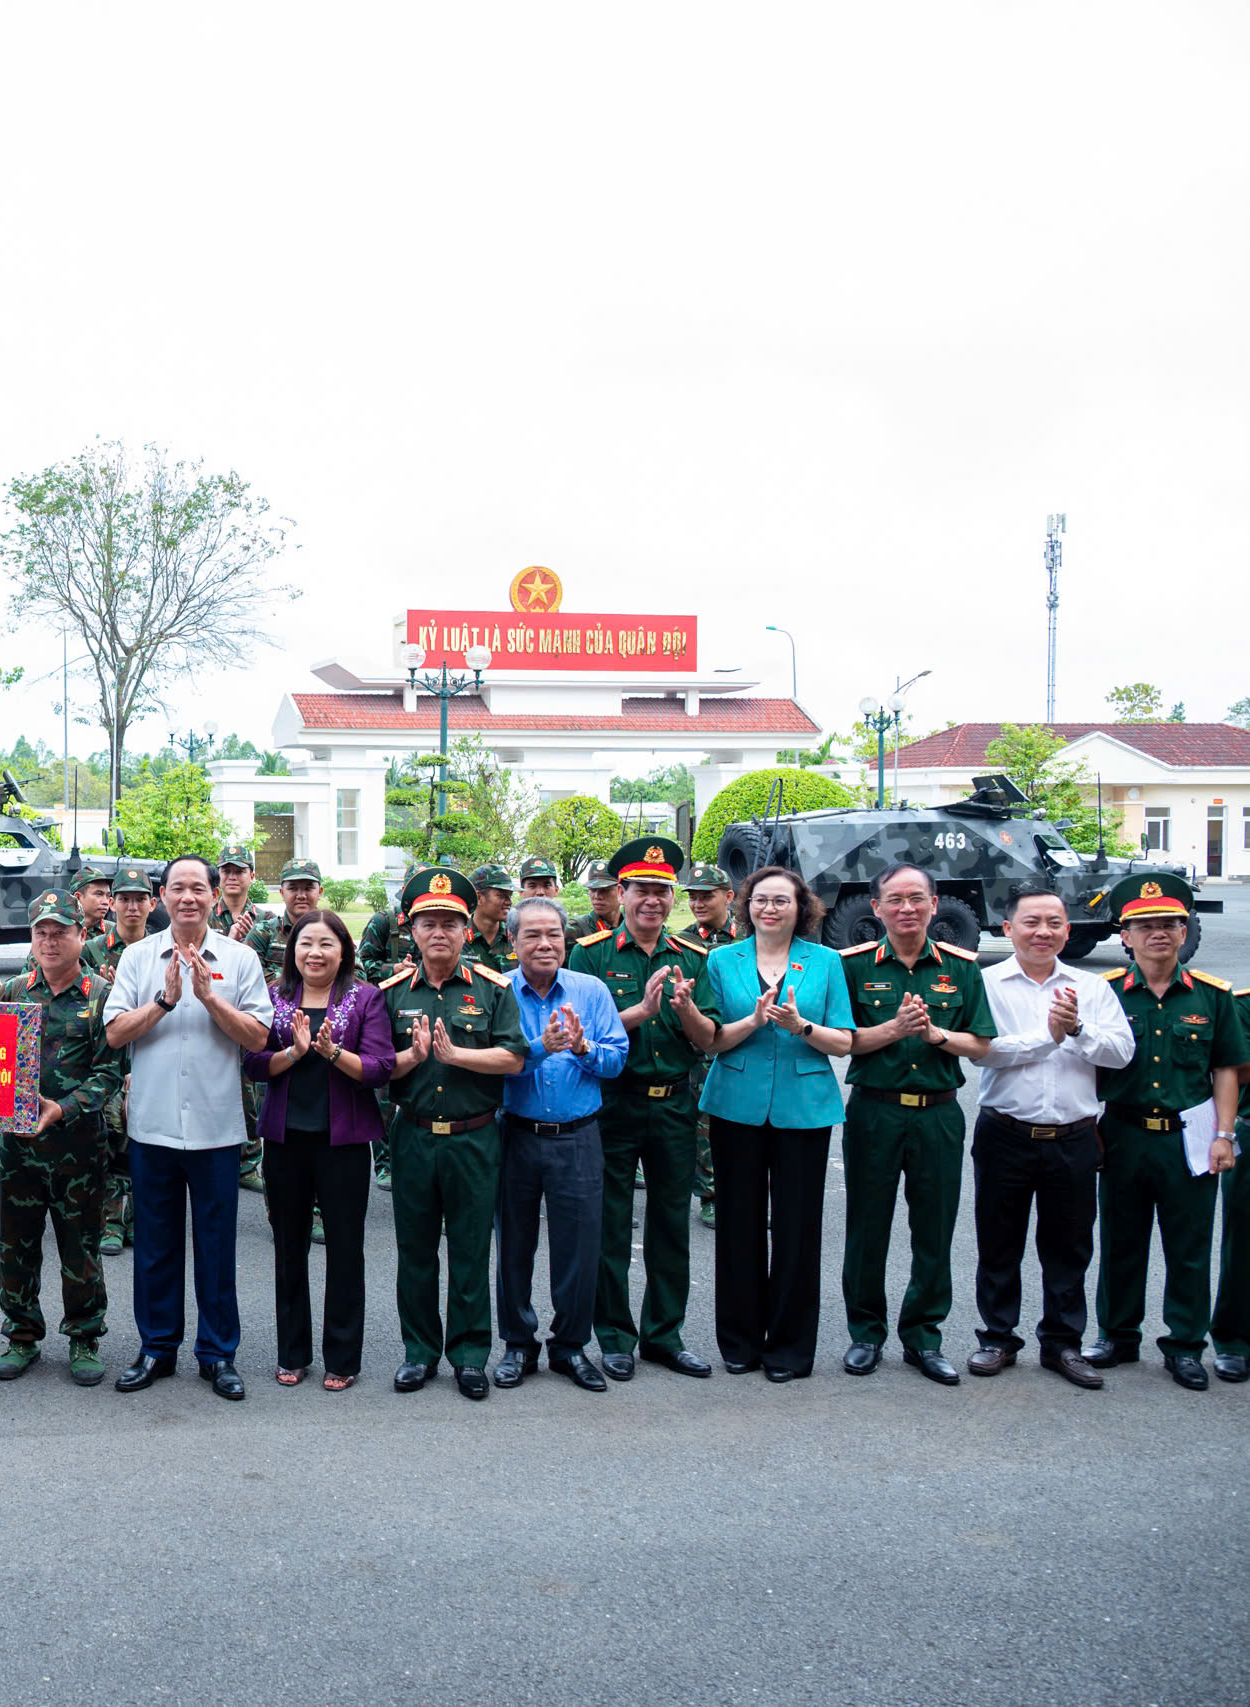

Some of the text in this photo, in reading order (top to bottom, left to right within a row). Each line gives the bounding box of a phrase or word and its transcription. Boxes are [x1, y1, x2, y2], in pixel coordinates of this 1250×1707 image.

[418, 619, 438, 652] KỶ
[443, 622, 480, 656] LUẬT
[484, 624, 502, 653] LÀ
[507, 622, 535, 653] SỨC
[538, 629, 582, 658] MẠNH
[585, 622, 614, 655] CỦA
[618, 626, 657, 659] QUÂN
[935, 832, 966, 850] 463
